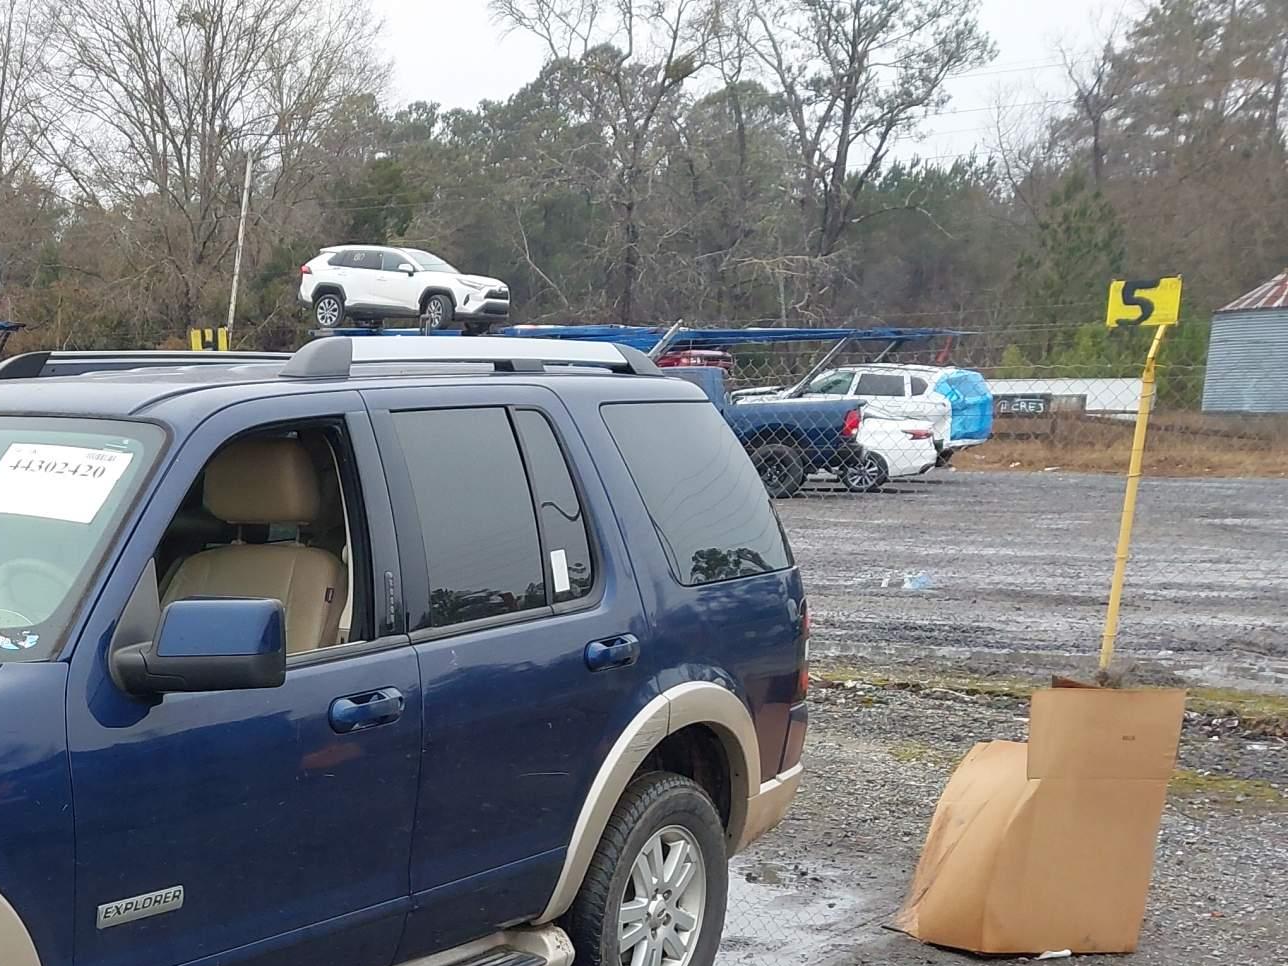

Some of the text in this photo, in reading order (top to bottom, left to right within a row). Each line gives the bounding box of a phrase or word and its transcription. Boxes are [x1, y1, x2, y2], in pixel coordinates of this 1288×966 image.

[1115, 279, 1160, 326] 5
[9, 458, 107, 479] 44302420
[103, 889, 182, 919] EXPLORER
